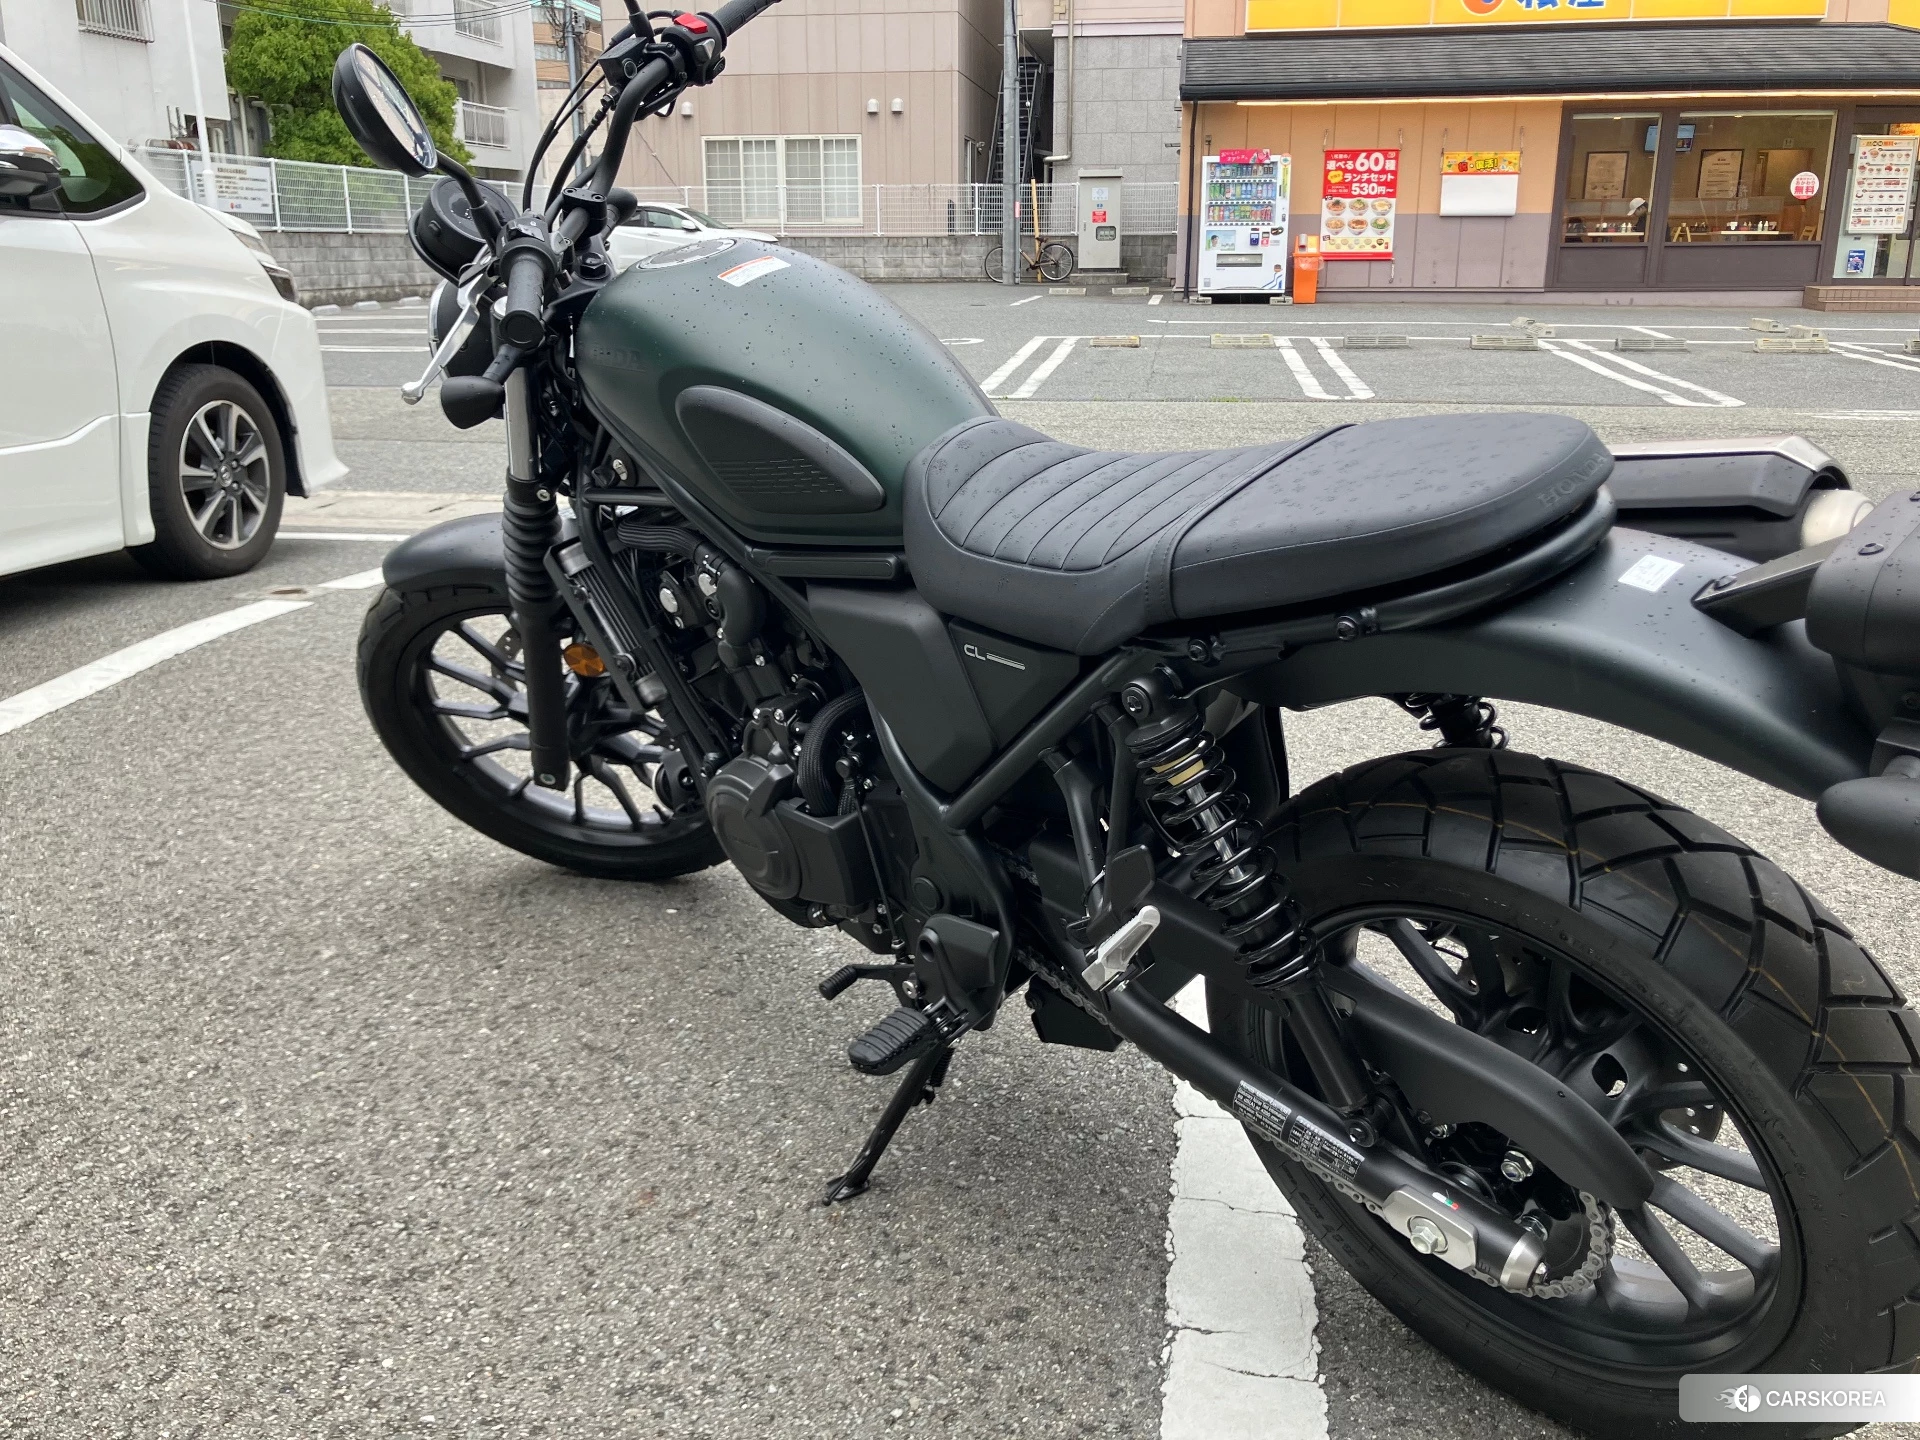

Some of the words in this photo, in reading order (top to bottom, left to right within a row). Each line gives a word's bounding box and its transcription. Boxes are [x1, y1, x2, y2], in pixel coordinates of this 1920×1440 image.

[1344, 173, 1395, 182] ランチセット
[1794, 186, 1815, 194] 無料
[964, 644, 986, 660] CL
